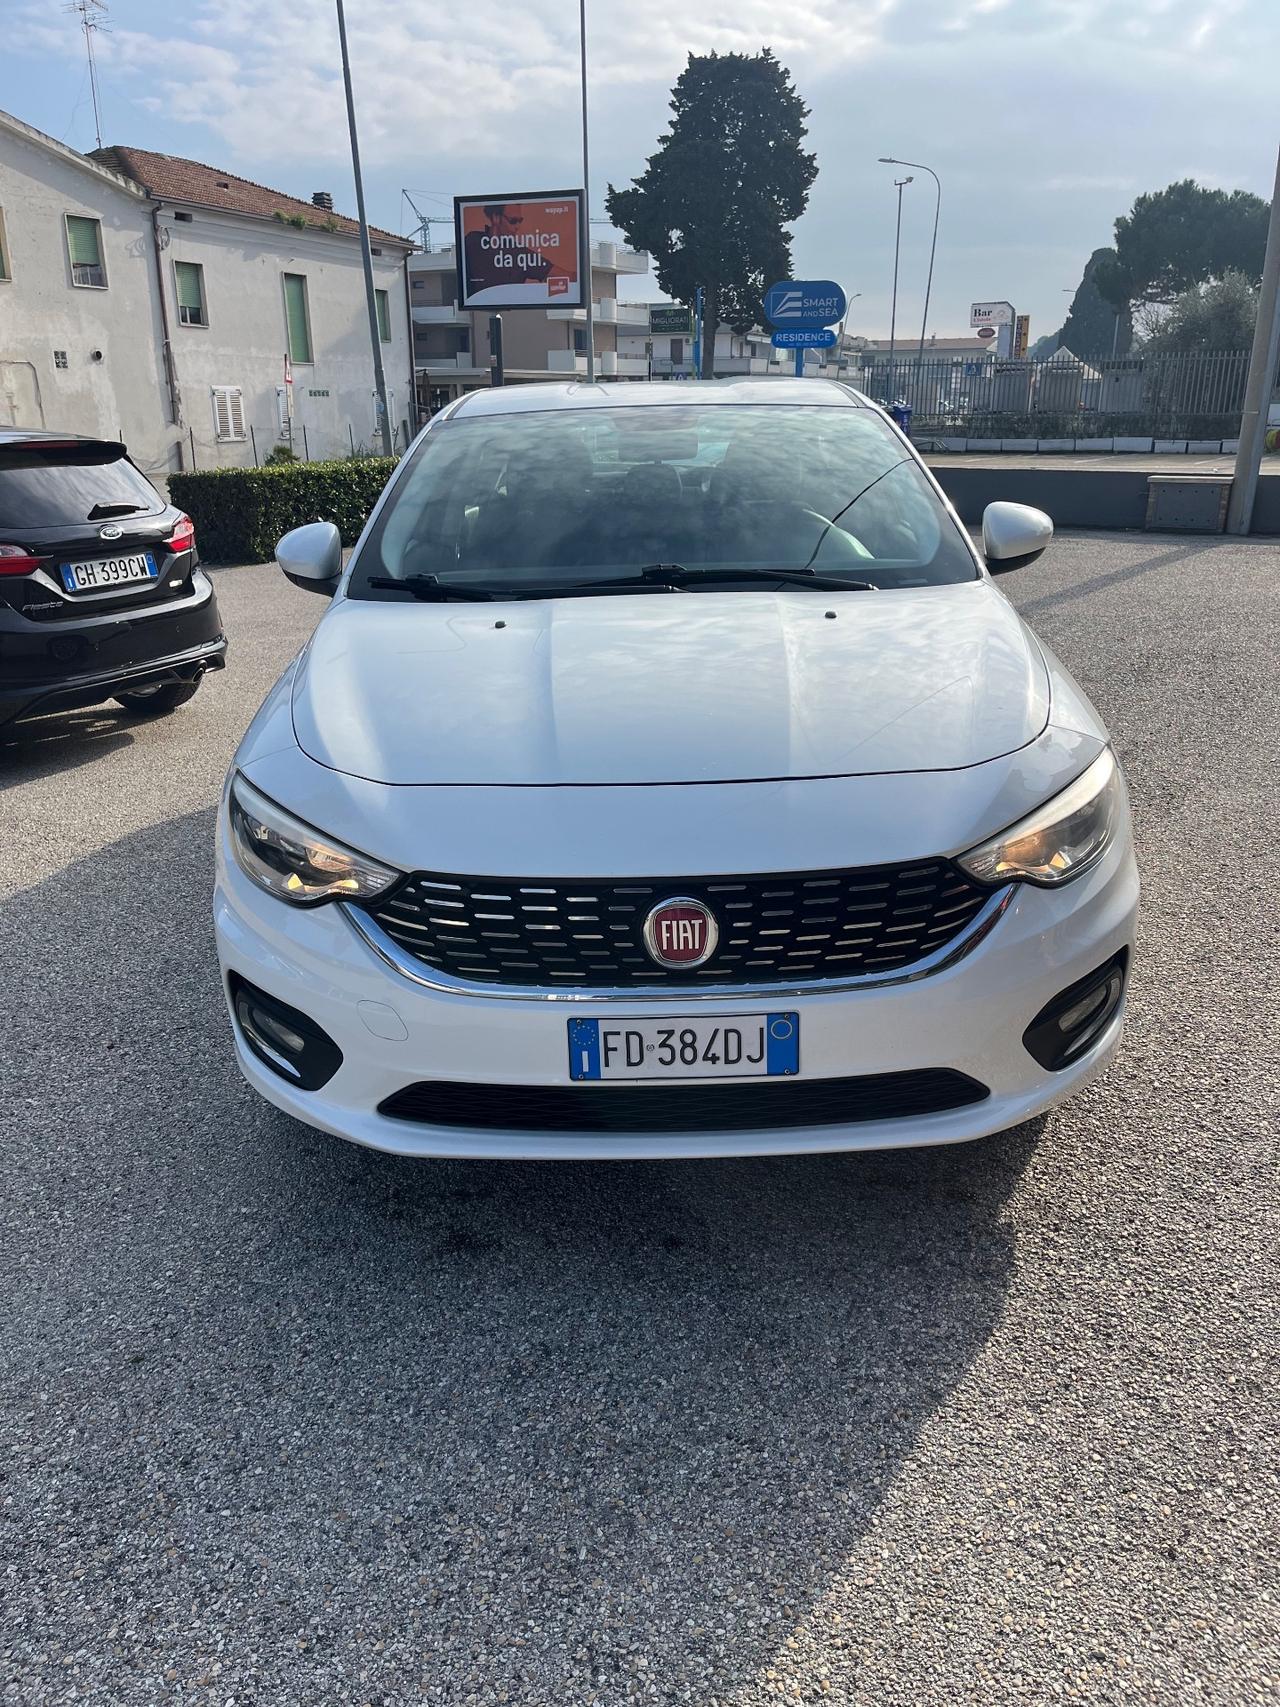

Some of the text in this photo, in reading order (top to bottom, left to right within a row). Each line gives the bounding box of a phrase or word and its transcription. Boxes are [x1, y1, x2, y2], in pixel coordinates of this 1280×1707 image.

[480, 229, 560, 250] comunica
[493, 248, 547, 271] da qui.
[803, 297, 839, 308] SMART
[818, 307, 839, 317] SEA
[973, 308, 993, 318] Bar
[775, 332, 831, 342] RESIDENCE
[661, 919, 703, 951] FIAT
